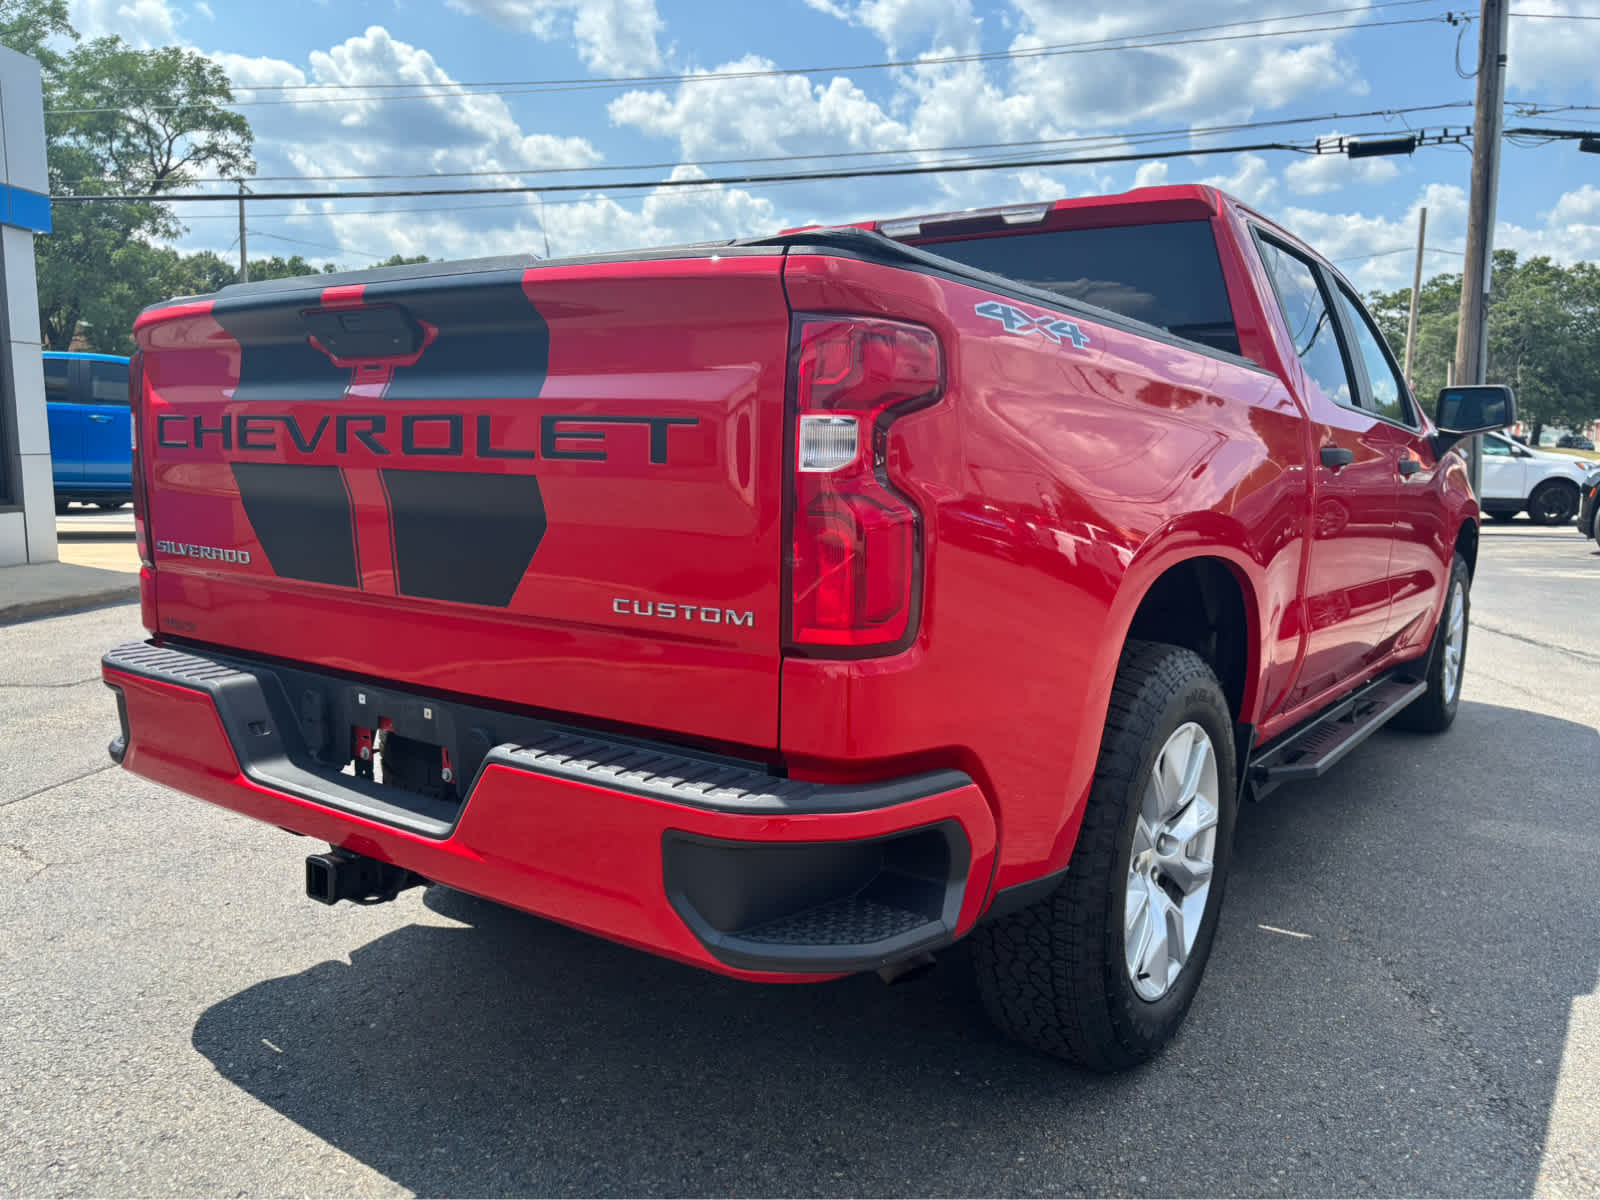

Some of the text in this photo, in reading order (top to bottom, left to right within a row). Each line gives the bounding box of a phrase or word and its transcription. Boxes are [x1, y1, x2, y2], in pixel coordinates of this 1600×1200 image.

[157, 413, 699, 465] CHEVROLET
[156, 540, 251, 565] SILVERADO
[612, 598, 755, 627] CUSTOM
